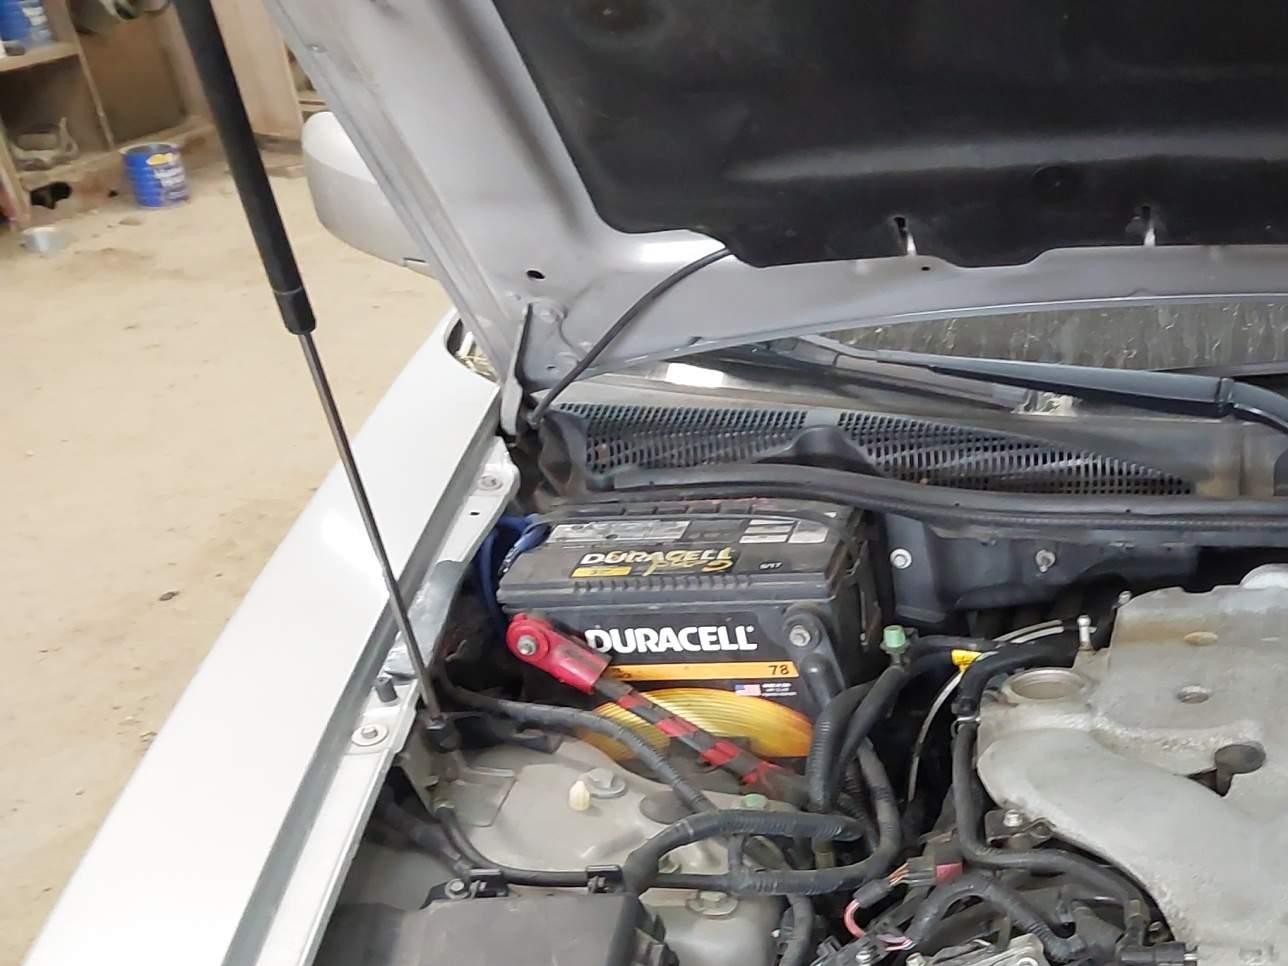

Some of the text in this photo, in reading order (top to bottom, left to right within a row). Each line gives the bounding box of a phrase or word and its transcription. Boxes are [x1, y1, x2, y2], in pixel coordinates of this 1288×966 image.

[580, 548, 732, 565] DURACELL
[584, 626, 758, 654] DURACELL
[768, 664, 790, 676] 78
